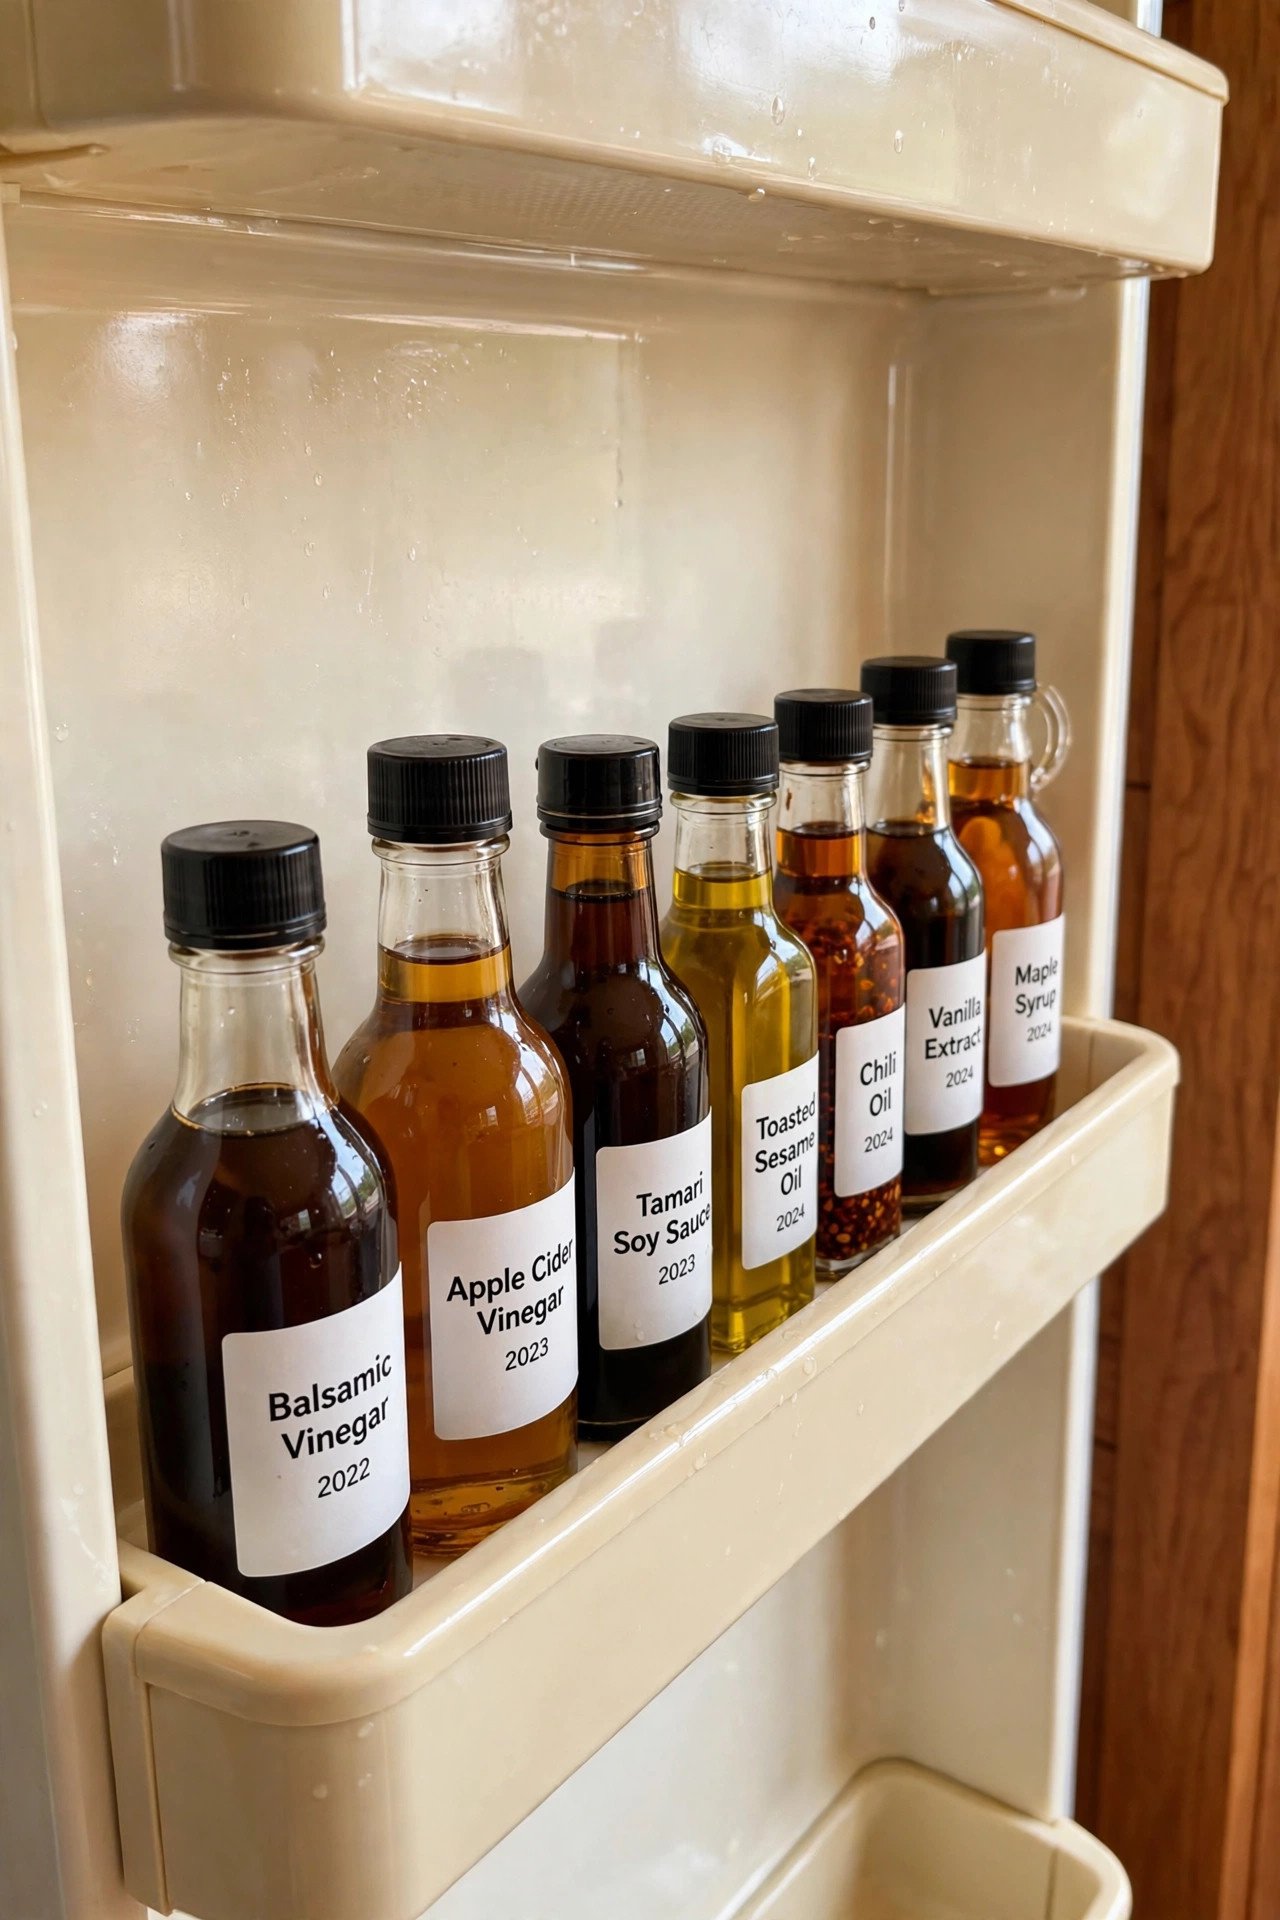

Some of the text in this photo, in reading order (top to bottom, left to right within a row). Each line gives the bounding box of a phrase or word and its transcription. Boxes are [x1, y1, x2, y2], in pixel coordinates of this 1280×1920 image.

[1015, 956, 1058, 986] Maple
[928, 997, 981, 1028] Vanilla
[1015, 989, 1056, 1018] Syrup
[925, 1026, 981, 1060] Extract
[1027, 1022, 1051, 1042] 2024
[860, 1051, 896, 1086] Chili
[946, 1065, 973, 1088] 2024
[756, 1092, 816, 1140] Toasted
[869, 1087, 891, 1117] Oil
[755, 1132, 815, 1173] Sesame
[864, 1126, 893, 1153] 2024
[636, 1171, 703, 1217] Tamari
[781, 1164, 802, 1195] Oil
[614, 1203, 710, 1257] Soy Sauce
[776, 1203, 805, 1232] 2024
[446, 1239, 573, 1307] Apple Cider
[659, 1253, 695, 1285] 2023
[477, 1285, 564, 1335] Vinegar
[505, 1337, 549, 1371] 2023
[269, 1354, 392, 1421] Balsamic
[281, 1396, 388, 1459] Vinegar
[318, 1457, 371, 1498] 2022
